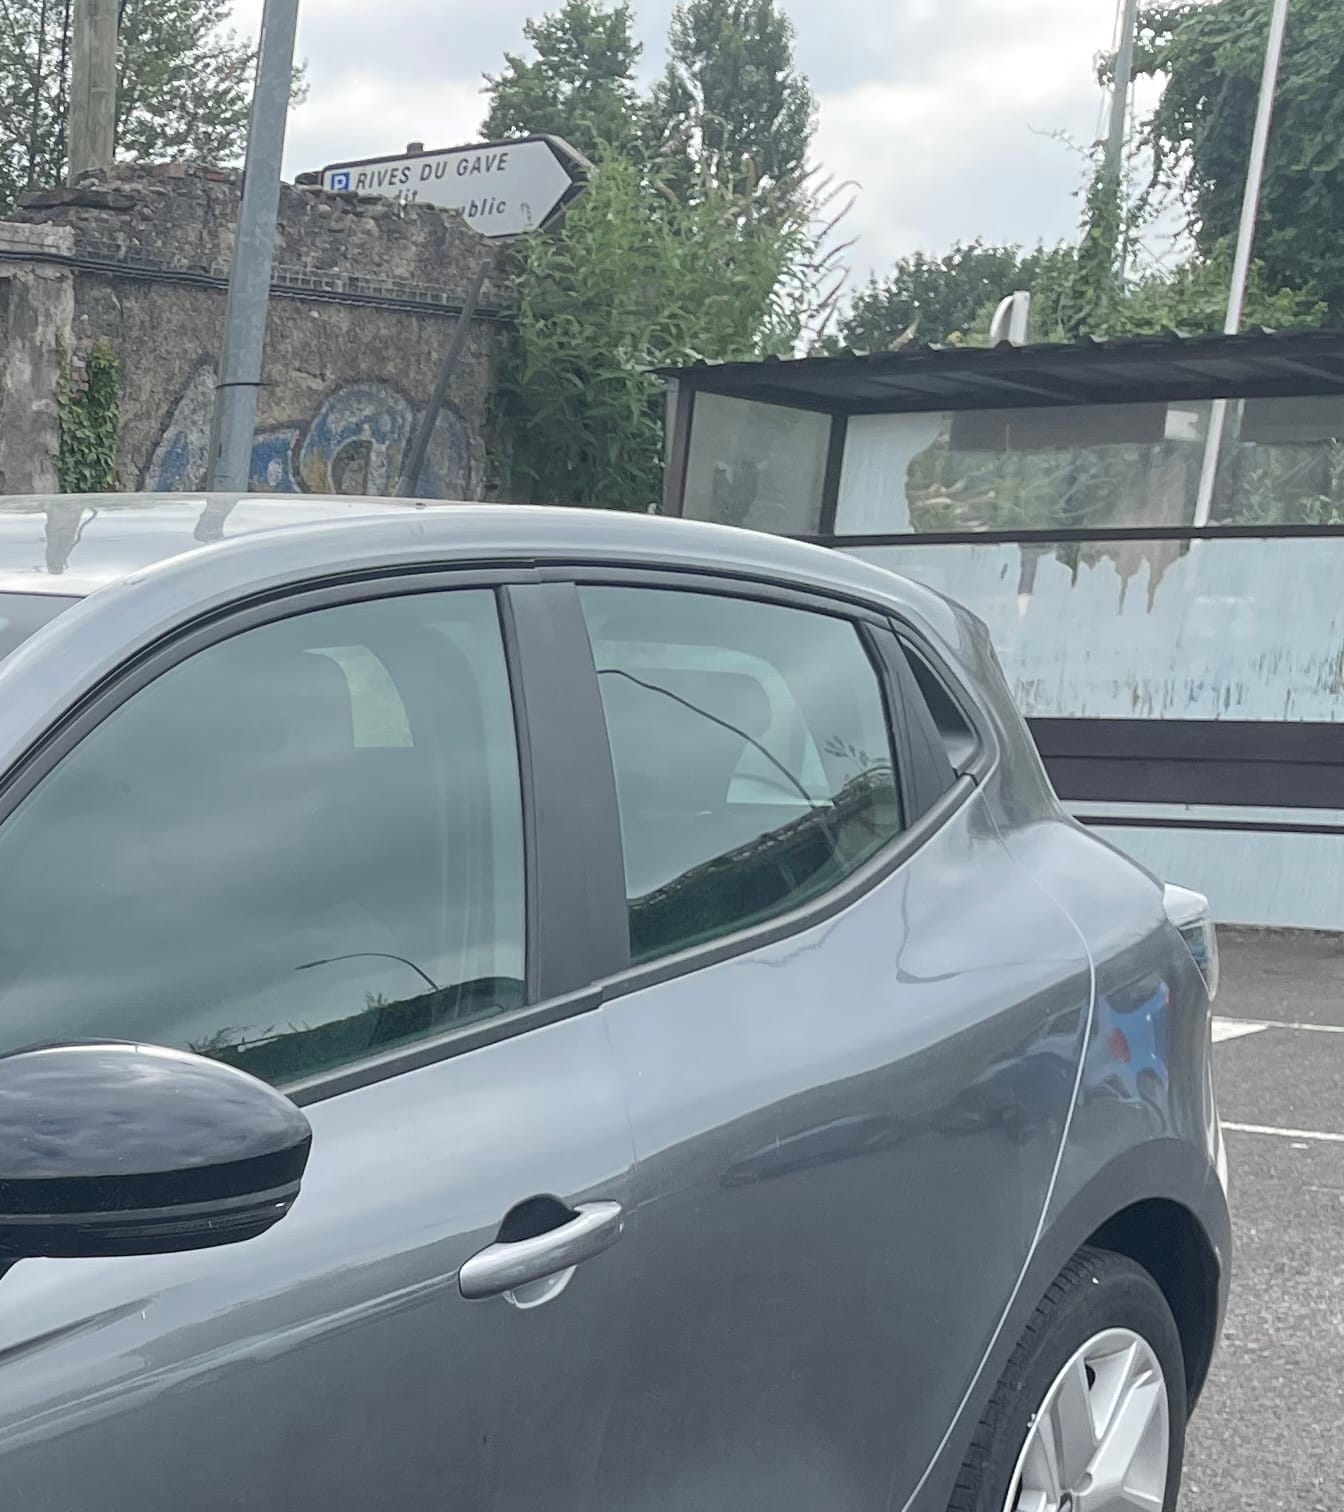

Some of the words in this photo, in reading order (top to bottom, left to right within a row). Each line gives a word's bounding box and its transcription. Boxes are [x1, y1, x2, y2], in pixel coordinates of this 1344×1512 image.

[355, 166, 411, 190] RIVES
[419, 161, 448, 182] DU
[456, 152, 510, 177] GAVE
